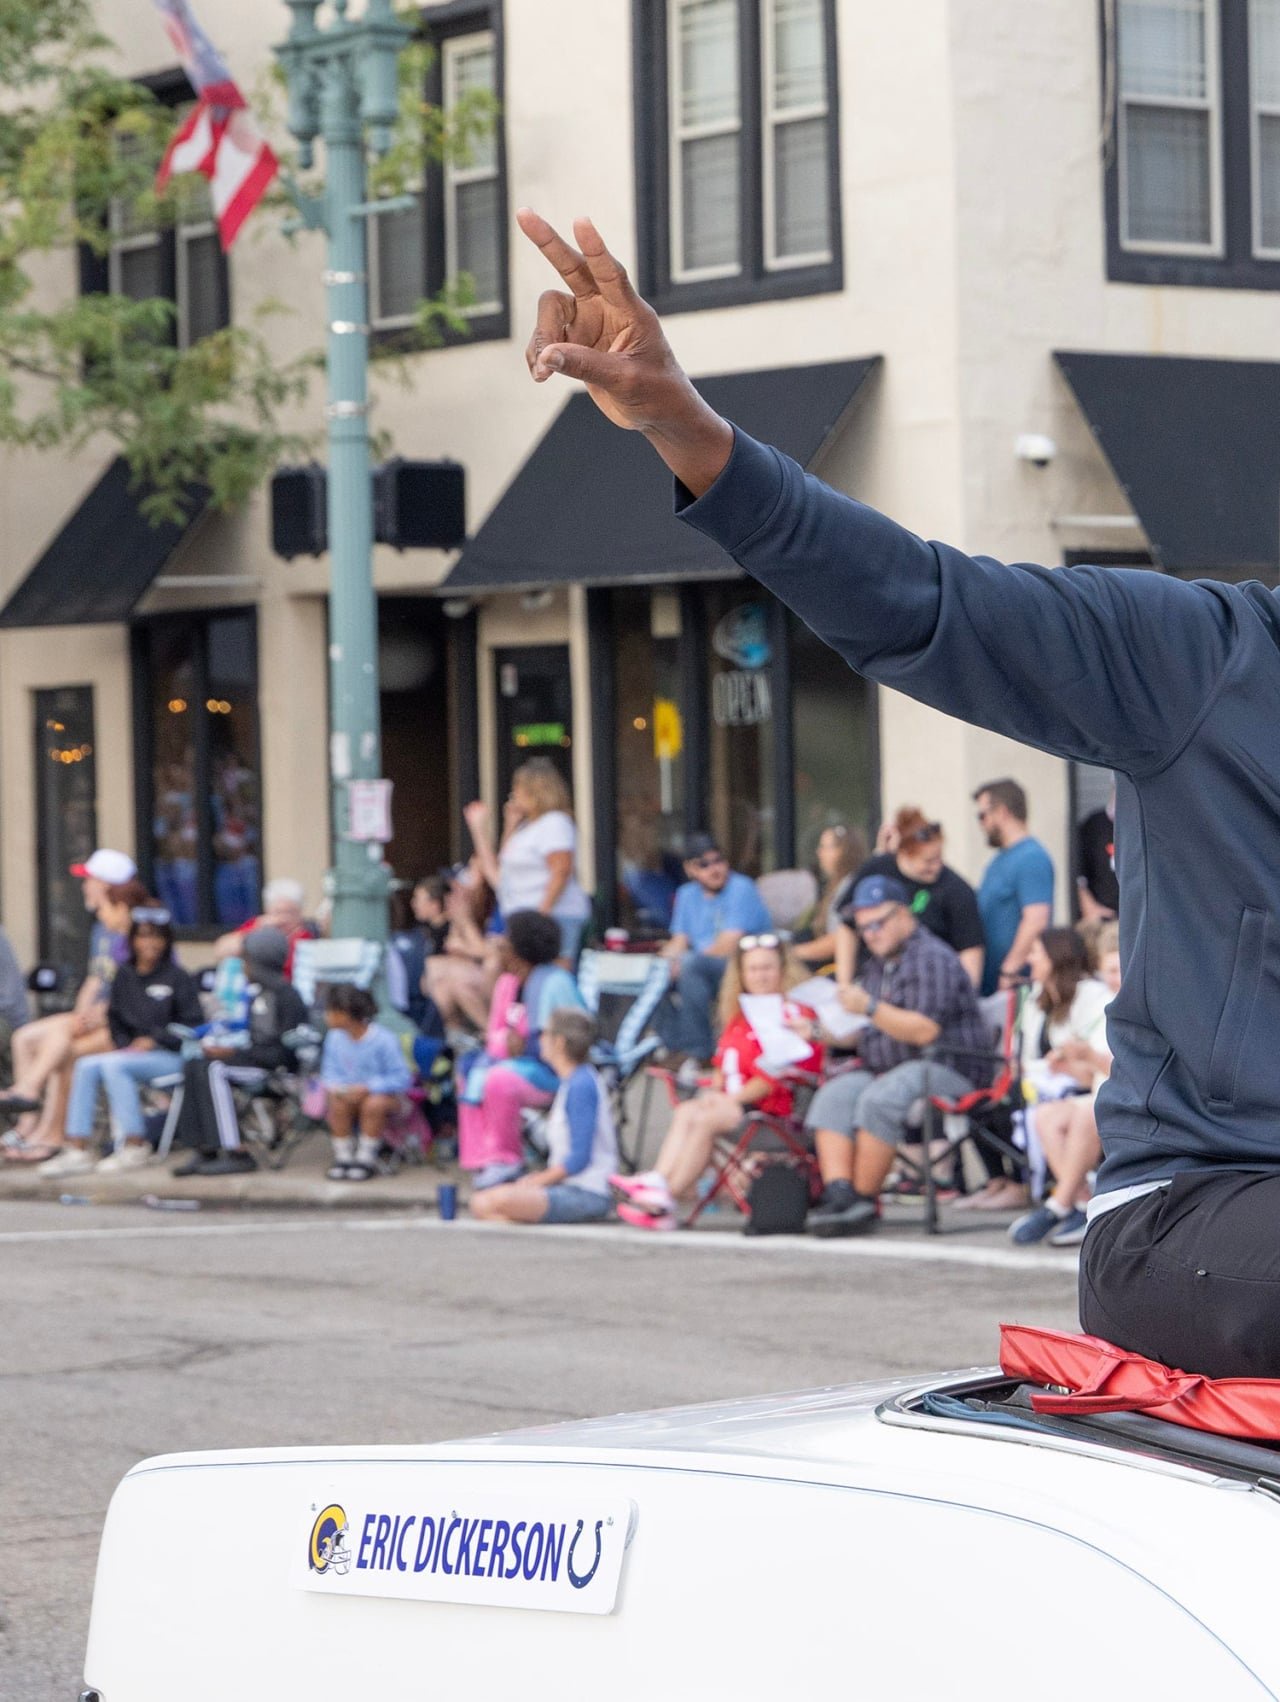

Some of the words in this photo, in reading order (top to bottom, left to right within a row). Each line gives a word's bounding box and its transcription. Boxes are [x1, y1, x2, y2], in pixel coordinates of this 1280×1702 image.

[713, 671, 772, 725] OPEN
[356, 1513, 416, 1572] ERIC
[413, 1516, 567, 1582] DICKERSON
